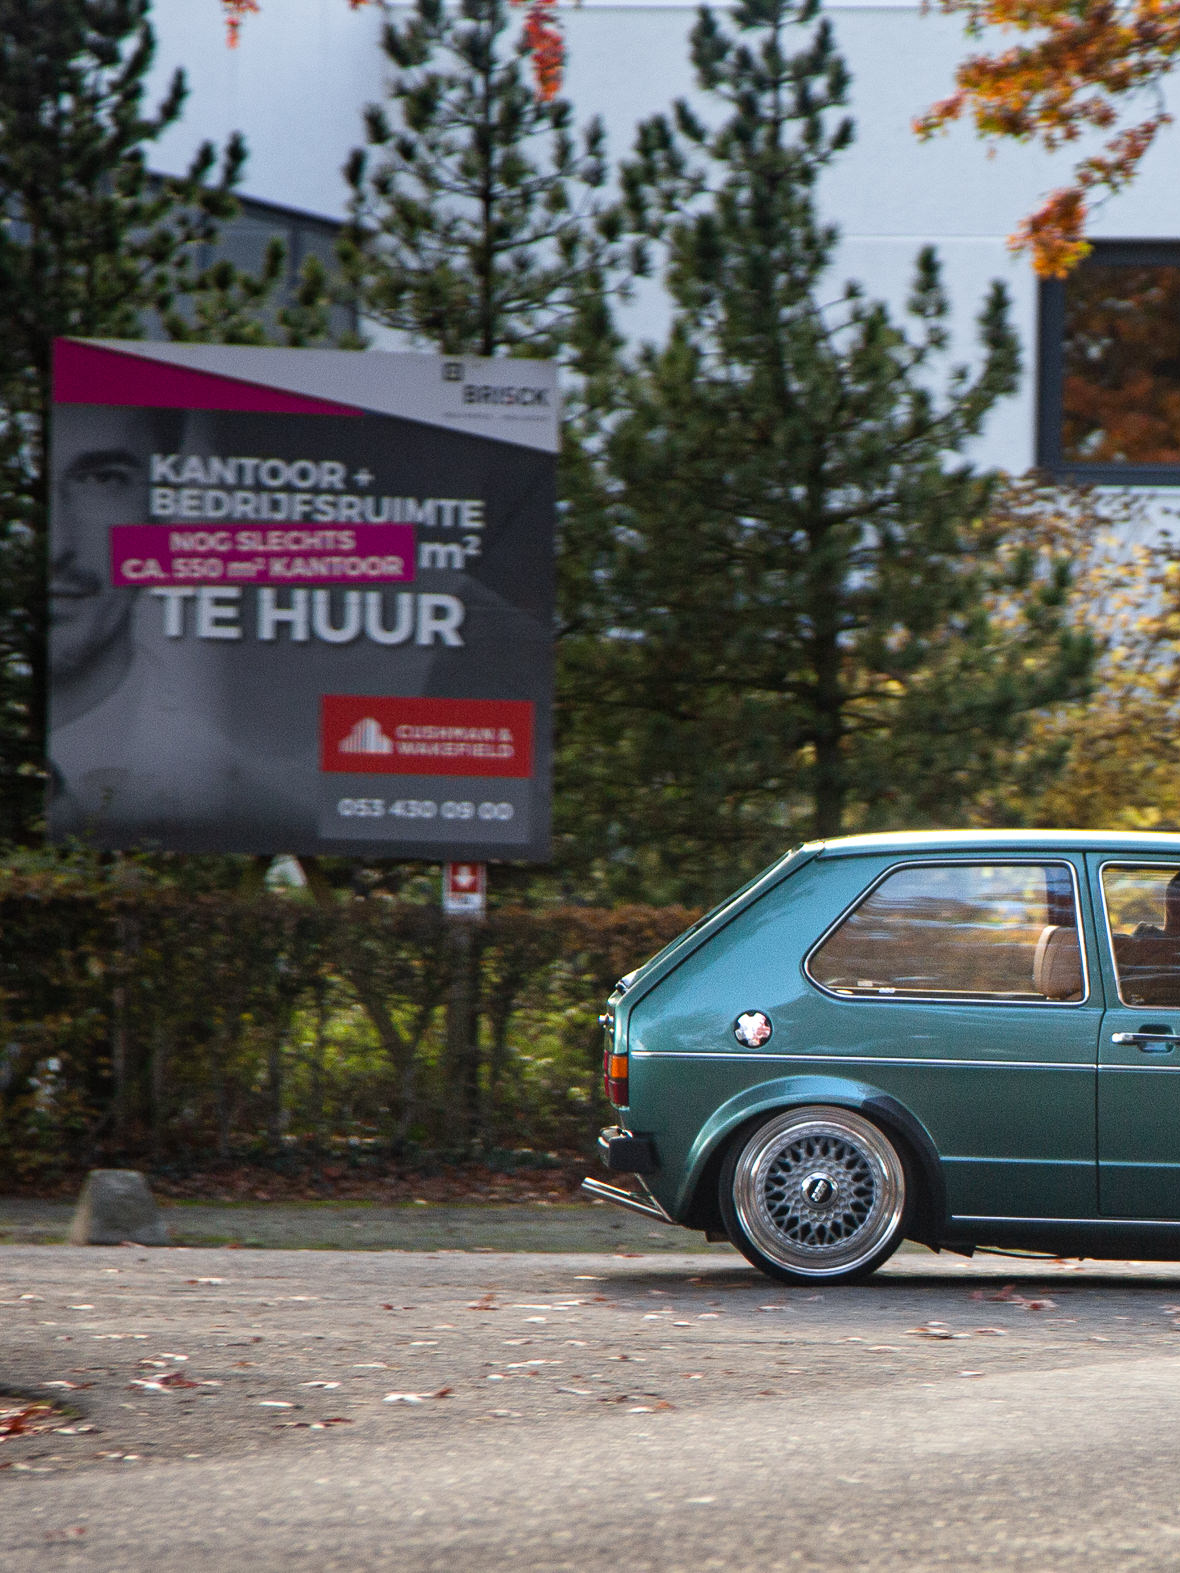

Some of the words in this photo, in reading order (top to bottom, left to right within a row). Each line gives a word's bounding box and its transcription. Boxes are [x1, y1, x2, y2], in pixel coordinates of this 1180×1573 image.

[151, 453, 346, 489] KANTOOR
[151, 487, 486, 528] BEDRIJFSRUIMTE
[169, 531, 232, 551] NOG
[235, 530, 357, 551] SLECHTS
[171, 557, 224, 577] 550
[269, 555, 404, 576] KANTOOR
[150, 585, 243, 640] TE
[257, 586, 466, 647] HUUR
[395, 724, 496, 741] CUSHMAN
[397, 741, 515, 758] WAKEFIELD
[337, 798, 386, 817] 053
[388, 799, 438, 819] 430
